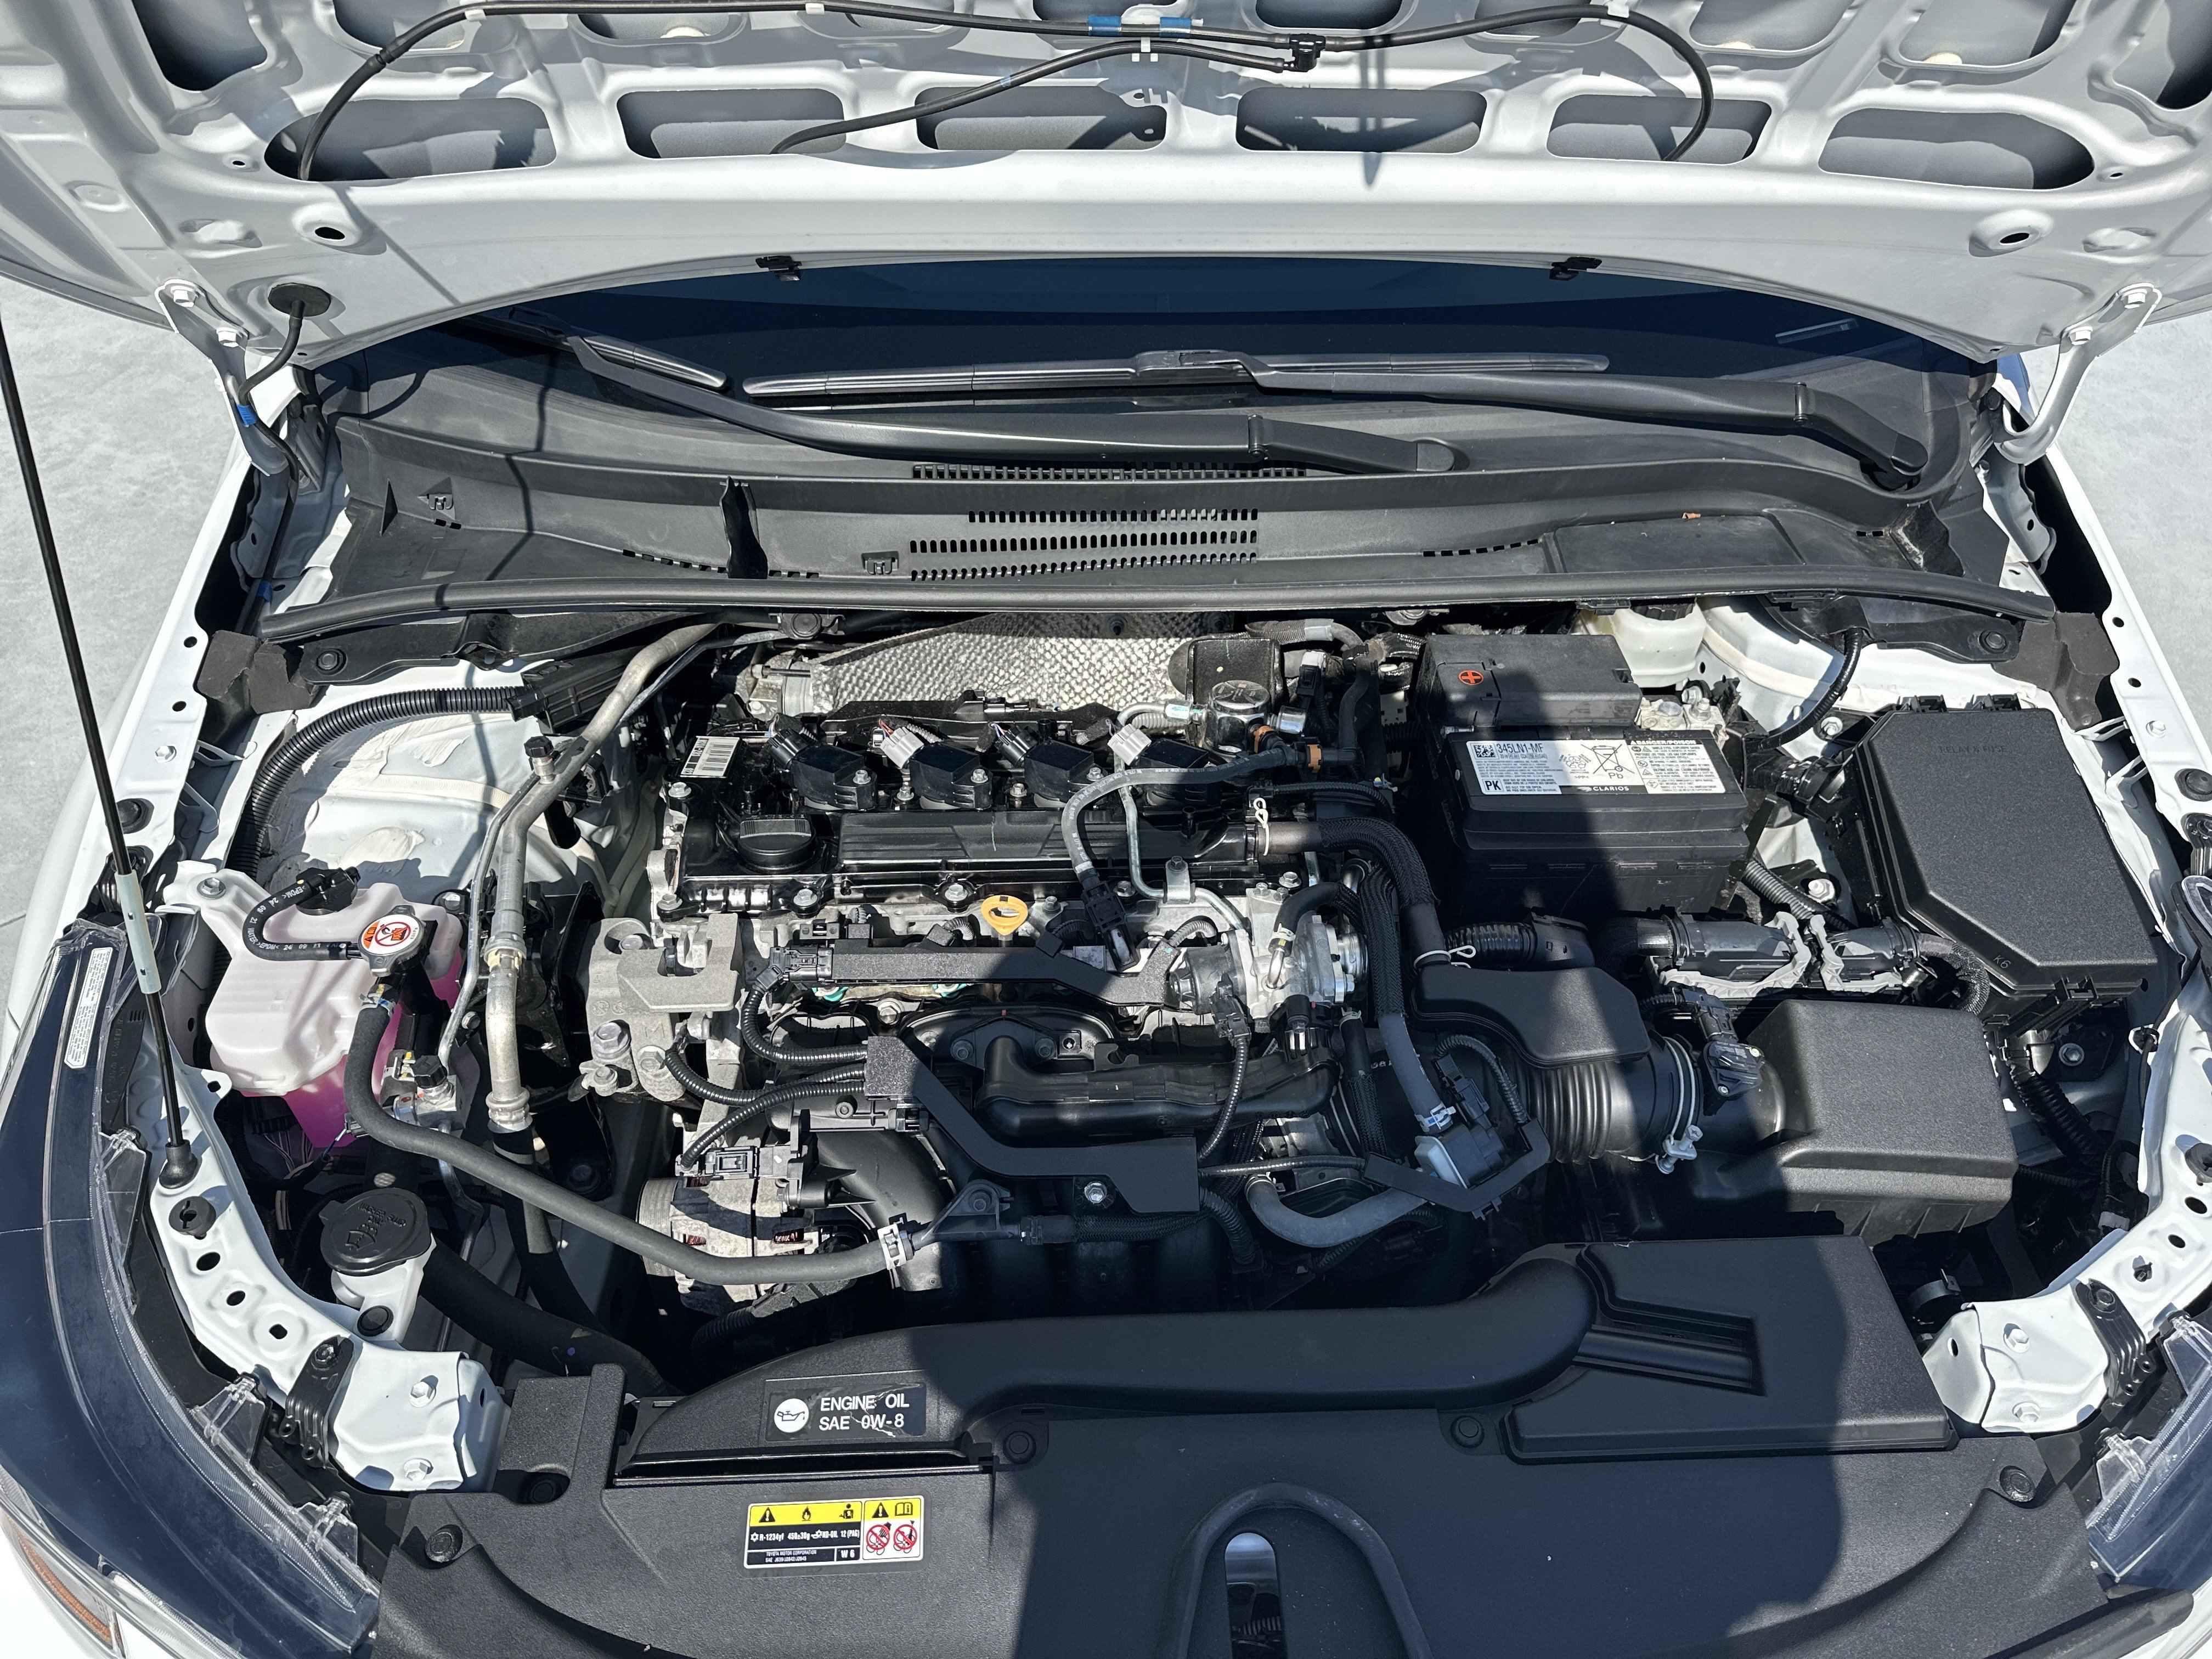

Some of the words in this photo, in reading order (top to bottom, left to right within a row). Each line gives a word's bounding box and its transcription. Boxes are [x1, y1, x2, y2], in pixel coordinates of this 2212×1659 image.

[1496, 743, 1544, 753] 345LN1-MF
[1938, 746, 1970, 754] RELAY
[1485, 780, 1502, 791] PK
[1993, 955, 2011, 969] K6
[821, 1395, 876, 1412] ENGINE
[885, 1393, 910, 1408] OIL
[819, 1415, 850, 1431] SAE
[861, 1413, 904, 1429] 0W-8
[840, 1530, 846, 1538] 12
[847, 1529, 860, 1539] (PAG)
[840, 1550, 848, 1558] W
[850, 1549, 855, 1558] 6
